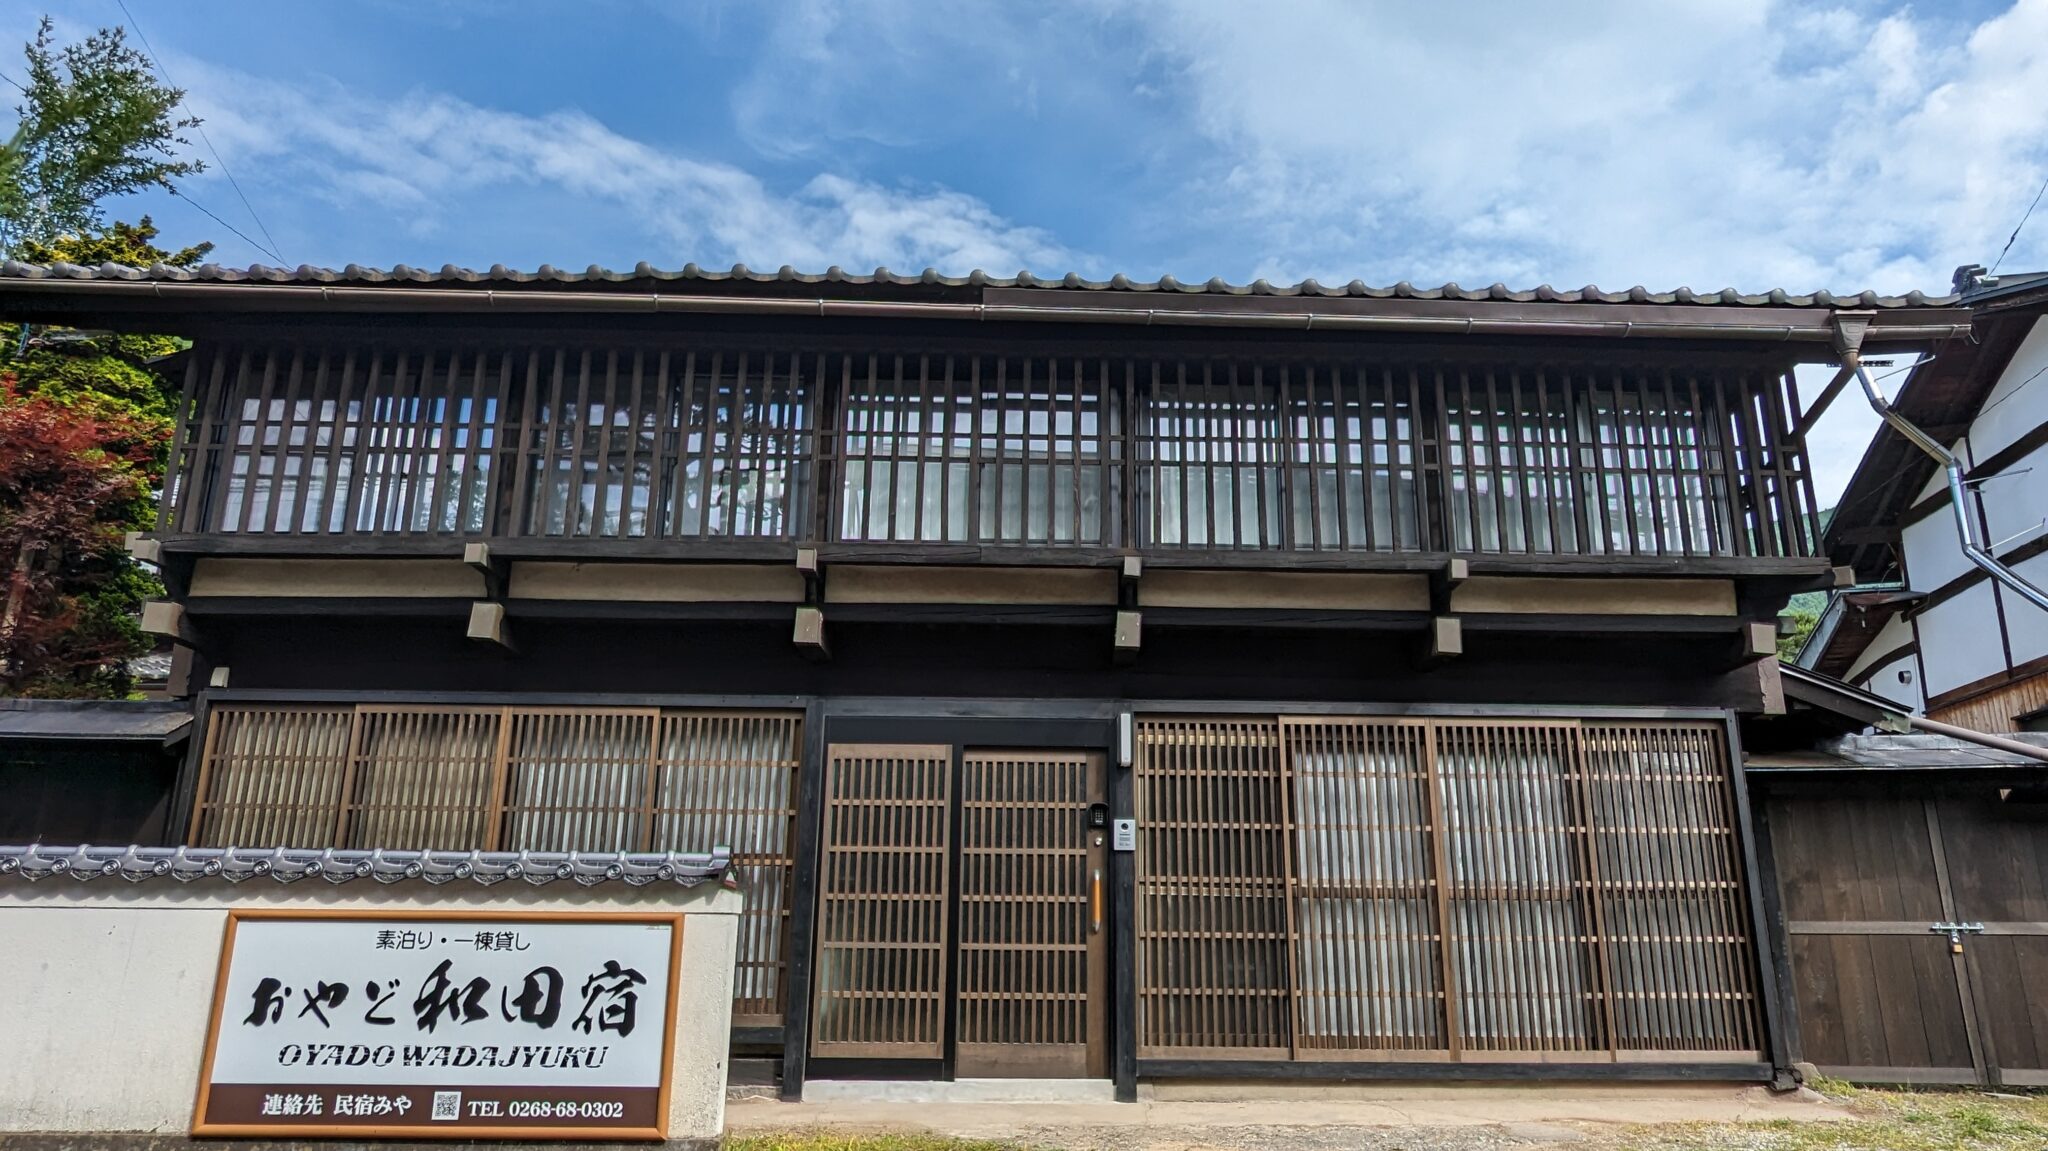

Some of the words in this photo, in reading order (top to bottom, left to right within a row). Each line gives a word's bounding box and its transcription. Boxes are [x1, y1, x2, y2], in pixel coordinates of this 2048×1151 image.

[376, 929, 531, 952] 素泊り・一棟貸し
[243, 958, 647, 1038] おやど和田宿
[278, 1043, 394, 1068] OYADO
[403, 1044, 609, 1069] WADAJYUKU
[261, 1093, 323, 1116] 連絡先
[333, 1094, 412, 1117] 民宿みや
[467, 1101, 505, 1117] TEL
[508, 1101, 624, 1118] 0268-68-0302
